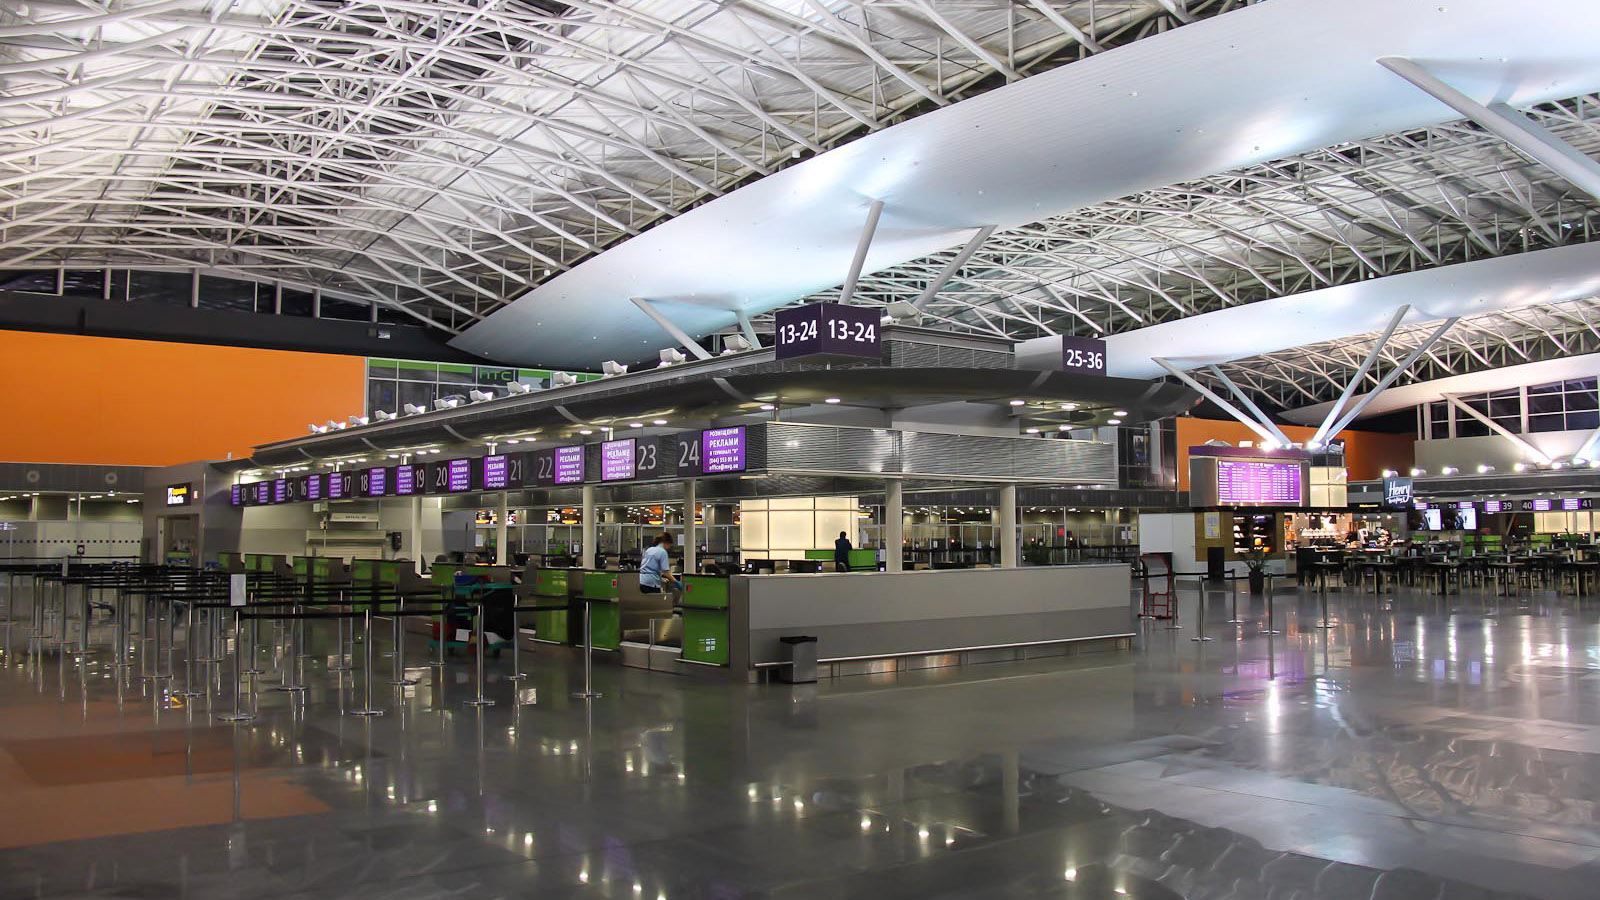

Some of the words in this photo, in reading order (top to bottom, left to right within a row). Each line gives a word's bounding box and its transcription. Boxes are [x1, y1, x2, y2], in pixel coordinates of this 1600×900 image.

[780, 320, 818, 345] 13-24
[828, 319, 876, 343] 13-24
[1066, 349, 1103, 370] 25-36
[709, 437, 739, 449] РЕКЛАМИ
[638, 444, 656, 470] 23
[678, 440, 700, 468] 24
[436, 466, 448, 487] 20
[510, 459, 521, 481] 21
[538, 456, 553, 479] 22
[300, 480, 307, 496] 16
[344, 475, 352, 493] 17
[360, 474, 368, 492] 18
[415, 468, 425, 488] 19
[287, 482, 293, 498] 15
[1388, 480, 1411, 503] Henry
[1502, 501, 1513, 510] 39
[1522, 501, 1532, 510] 40
[1582, 500, 1592, 508] 41
